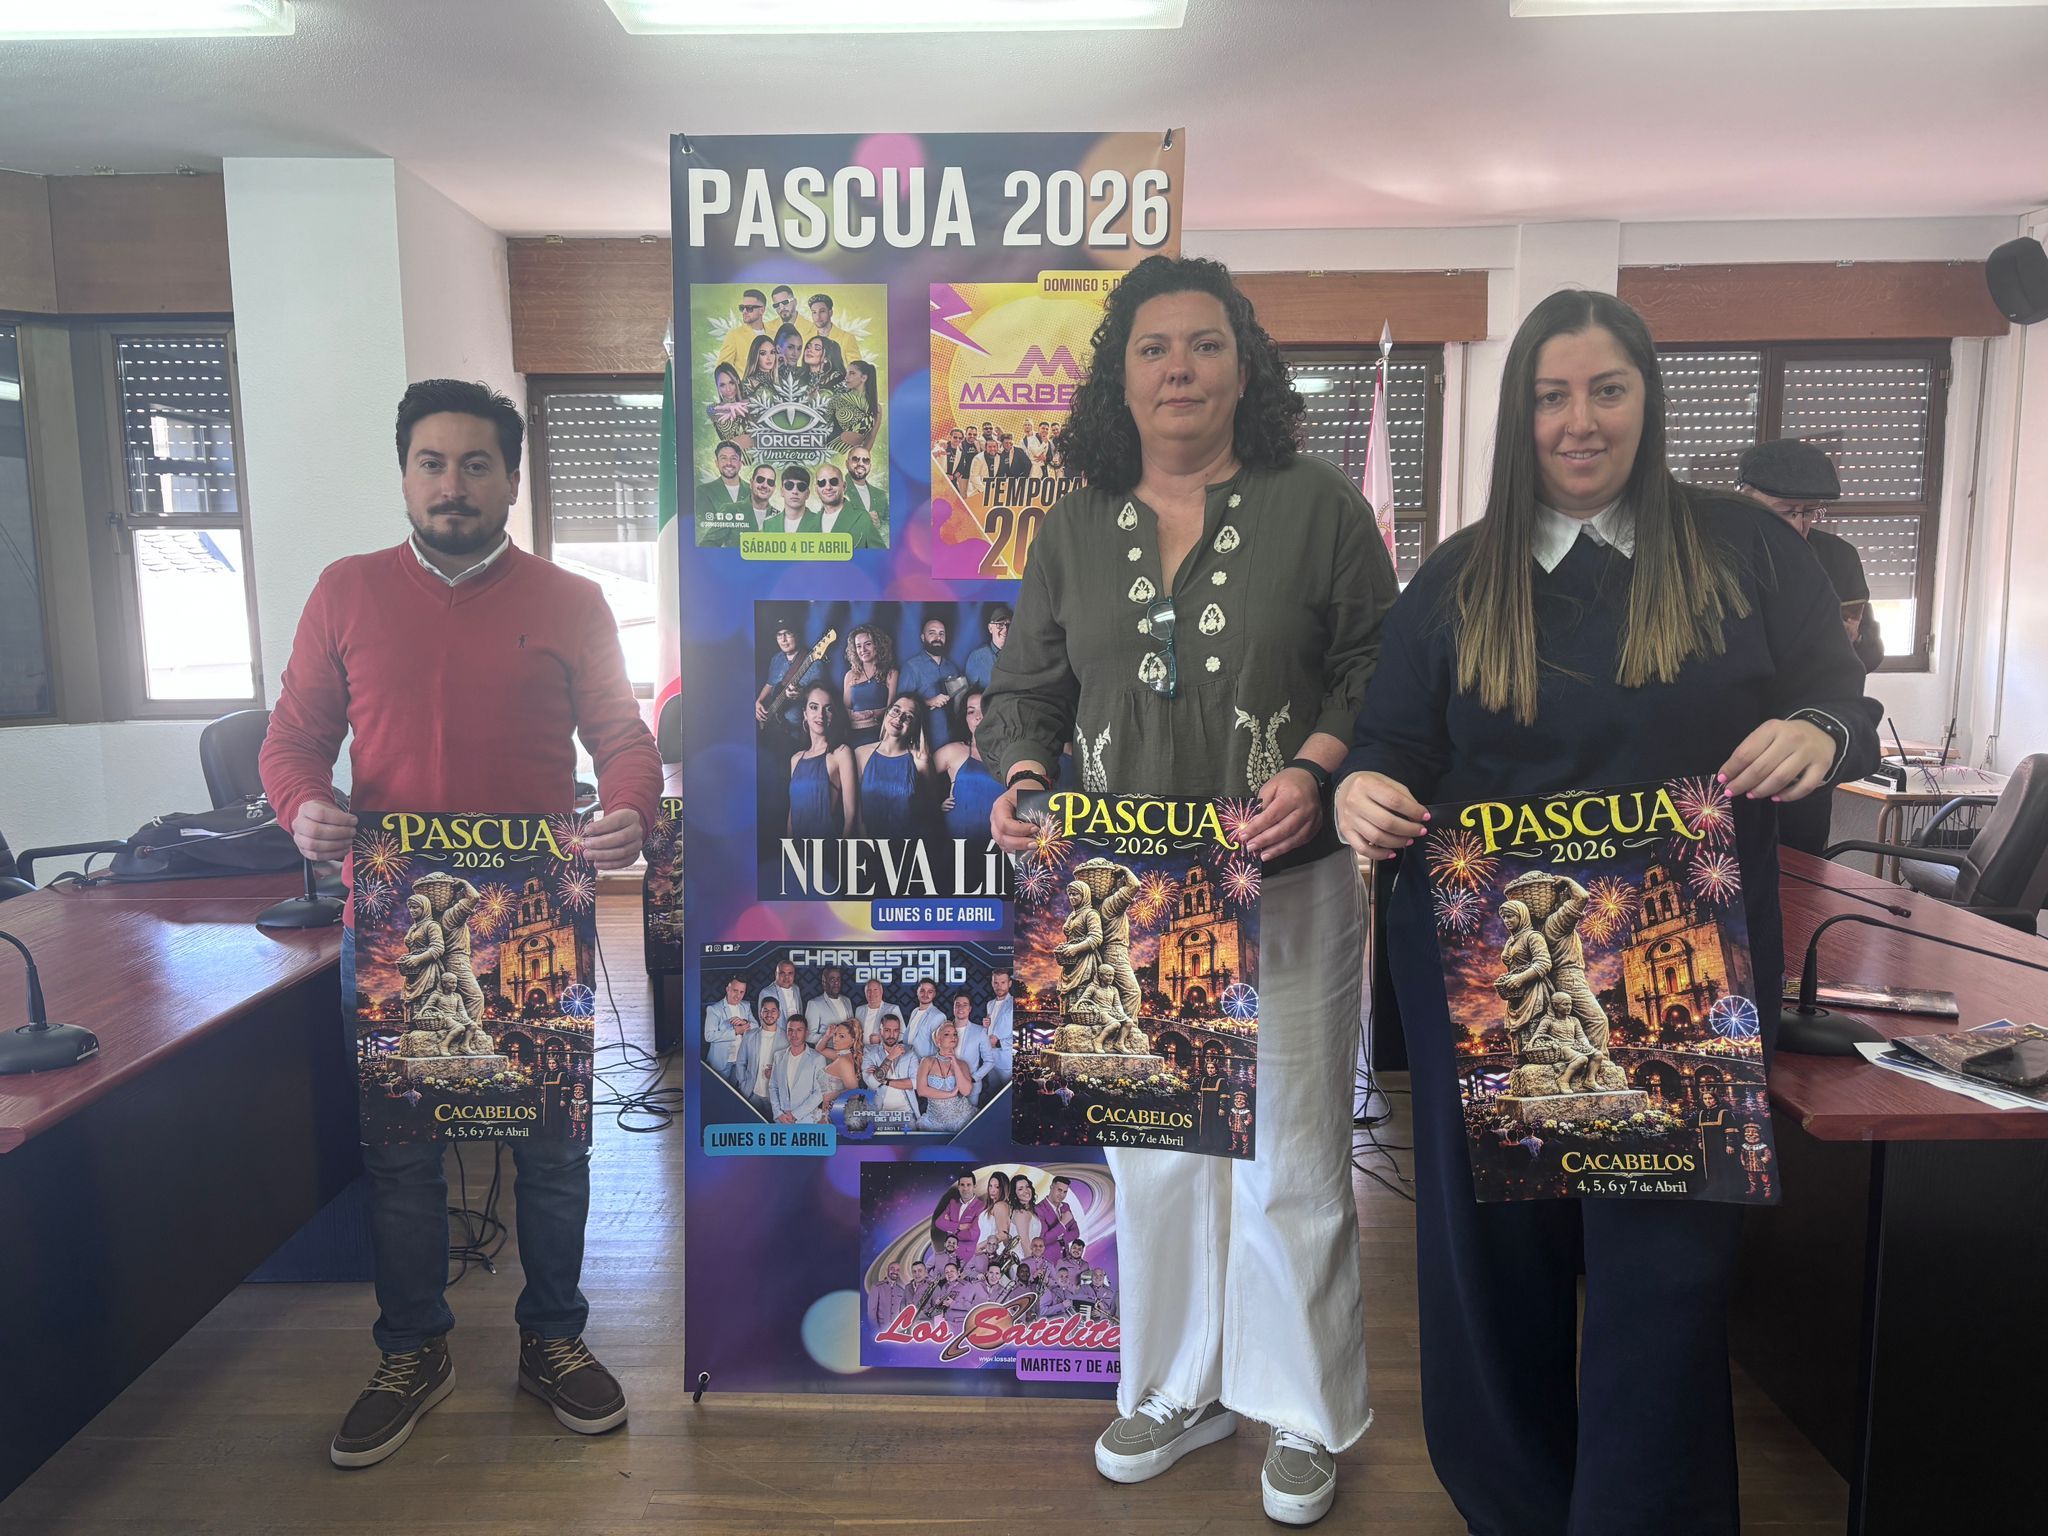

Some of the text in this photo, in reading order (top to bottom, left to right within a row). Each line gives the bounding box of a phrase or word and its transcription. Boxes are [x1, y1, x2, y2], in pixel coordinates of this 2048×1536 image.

[688, 165, 1170, 248] PASCUA 2026
[1044, 278, 1098, 292] DOMINGO
[1102, 279, 1109, 291] 5
[761, 434, 823, 447] ORIGEN
[764, 449, 817, 460] Invierno
[742, 537, 851, 554] SÁBADO 4 DE ABRIL
[1049, 792, 1239, 850] PASCUA
[1460, 787, 1705, 855] PASCUA
[382, 812, 573, 861] PASCUA
[1115, 836, 1168, 856] 2026
[1550, 838, 1617, 864] 2026
[452, 852, 505, 868] 2026
[779, 838, 939, 896] NUEVA
[878, 907, 995, 923] LUNES 6 DE ABRIL
[789, 949, 950, 967] CHARLESTON
[855, 967, 893, 983] BIG
[434, 1103, 537, 1122] CACABELOS
[1086, 1104, 1193, 1129] CACABELOS
[445, 1126, 529, 1138] 4, 5, 6 y 7 de Abril
[711, 1132, 829, 1147] LUNES 6 DE ABRIL
[1096, 1130, 1184, 1146] 4, 5, 6 y 7 de Abril
[1561, 1151, 1696, 1173] CACABELOS
[1577, 1180, 1688, 1194] 4, 5, 6 y 7 de Abril
[875, 1304, 953, 1343] Los
[1020, 1357, 1071, 1373] MARTES
[1075, 1360, 1081, 1373] 7
[1087, 1359, 1102, 1373] DE
